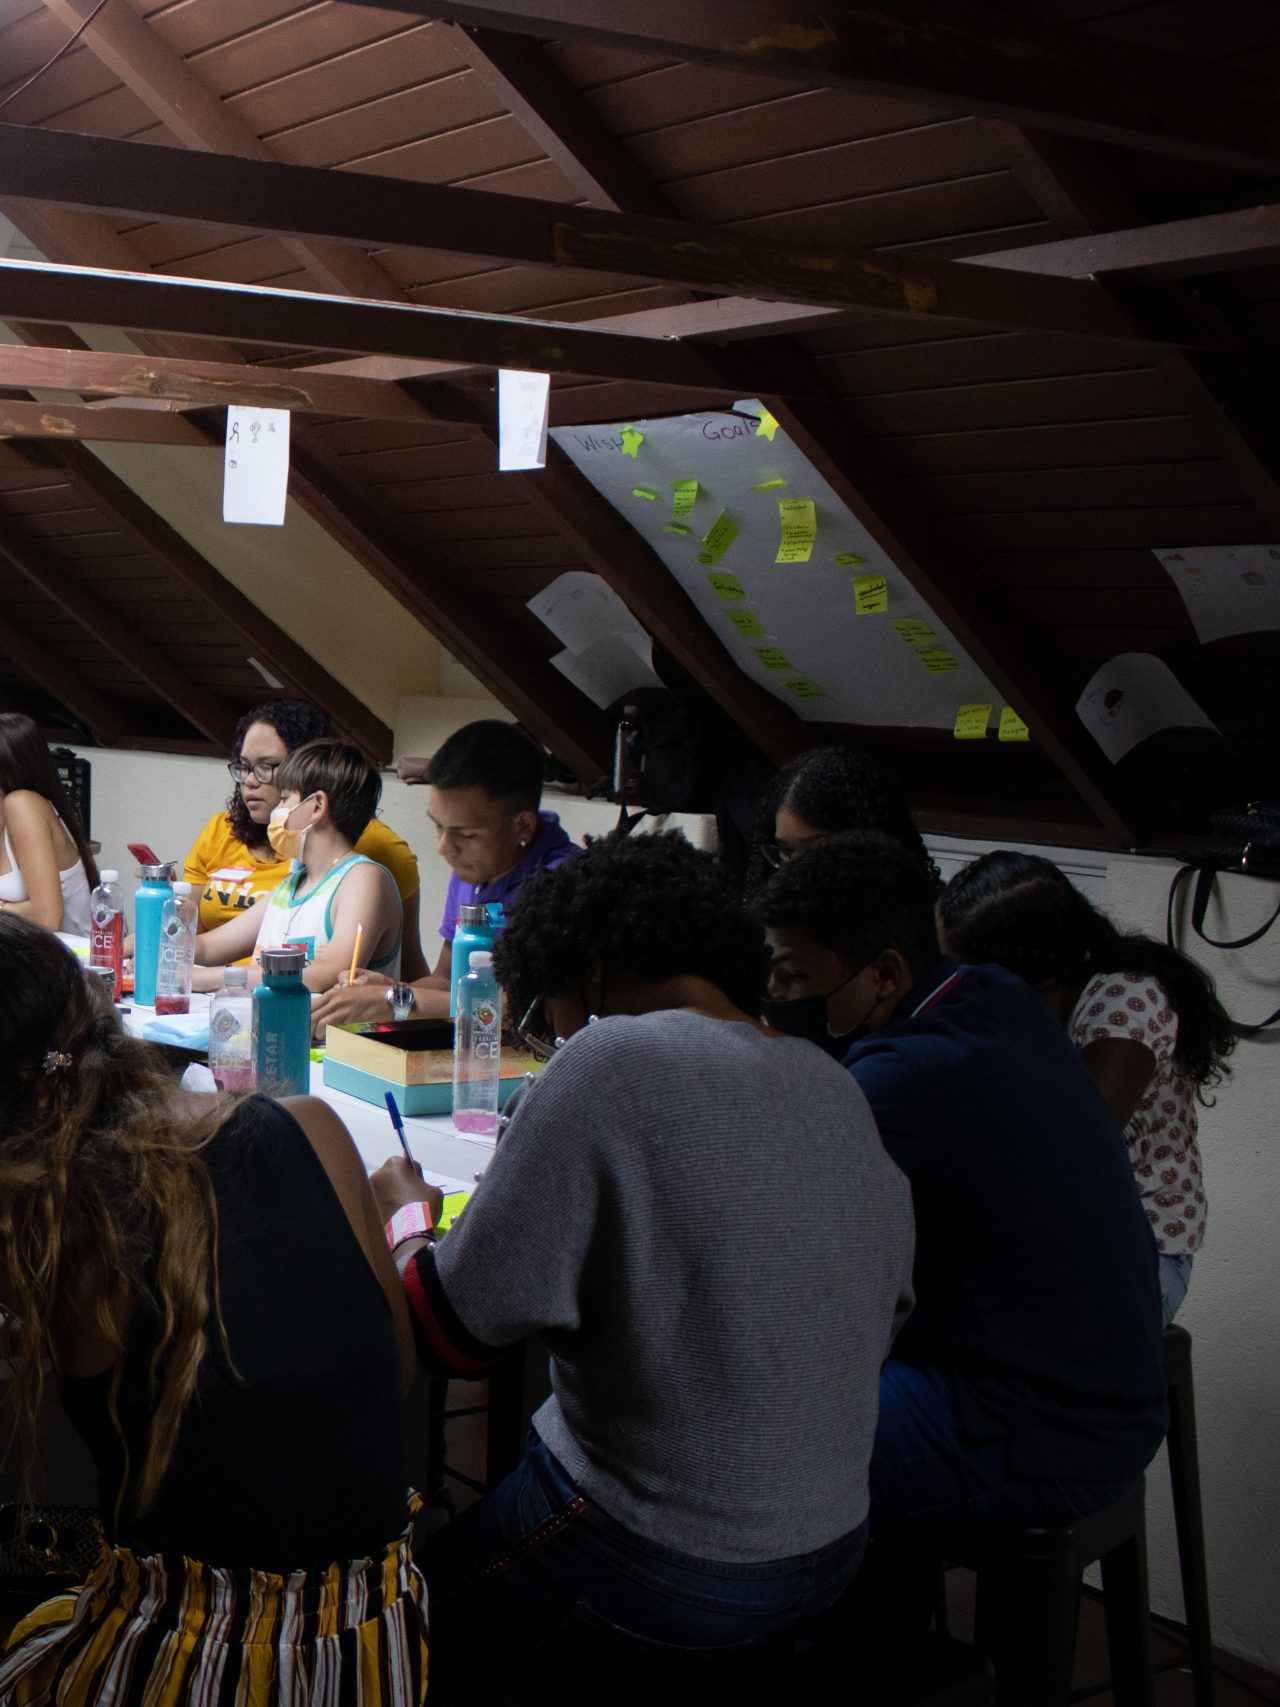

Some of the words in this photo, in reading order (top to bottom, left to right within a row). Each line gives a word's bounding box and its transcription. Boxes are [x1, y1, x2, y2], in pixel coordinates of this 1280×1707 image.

[91, 934, 114, 950] ICE
[161, 946, 184, 962] ICE
[471, 1041, 499, 1059] ICE
